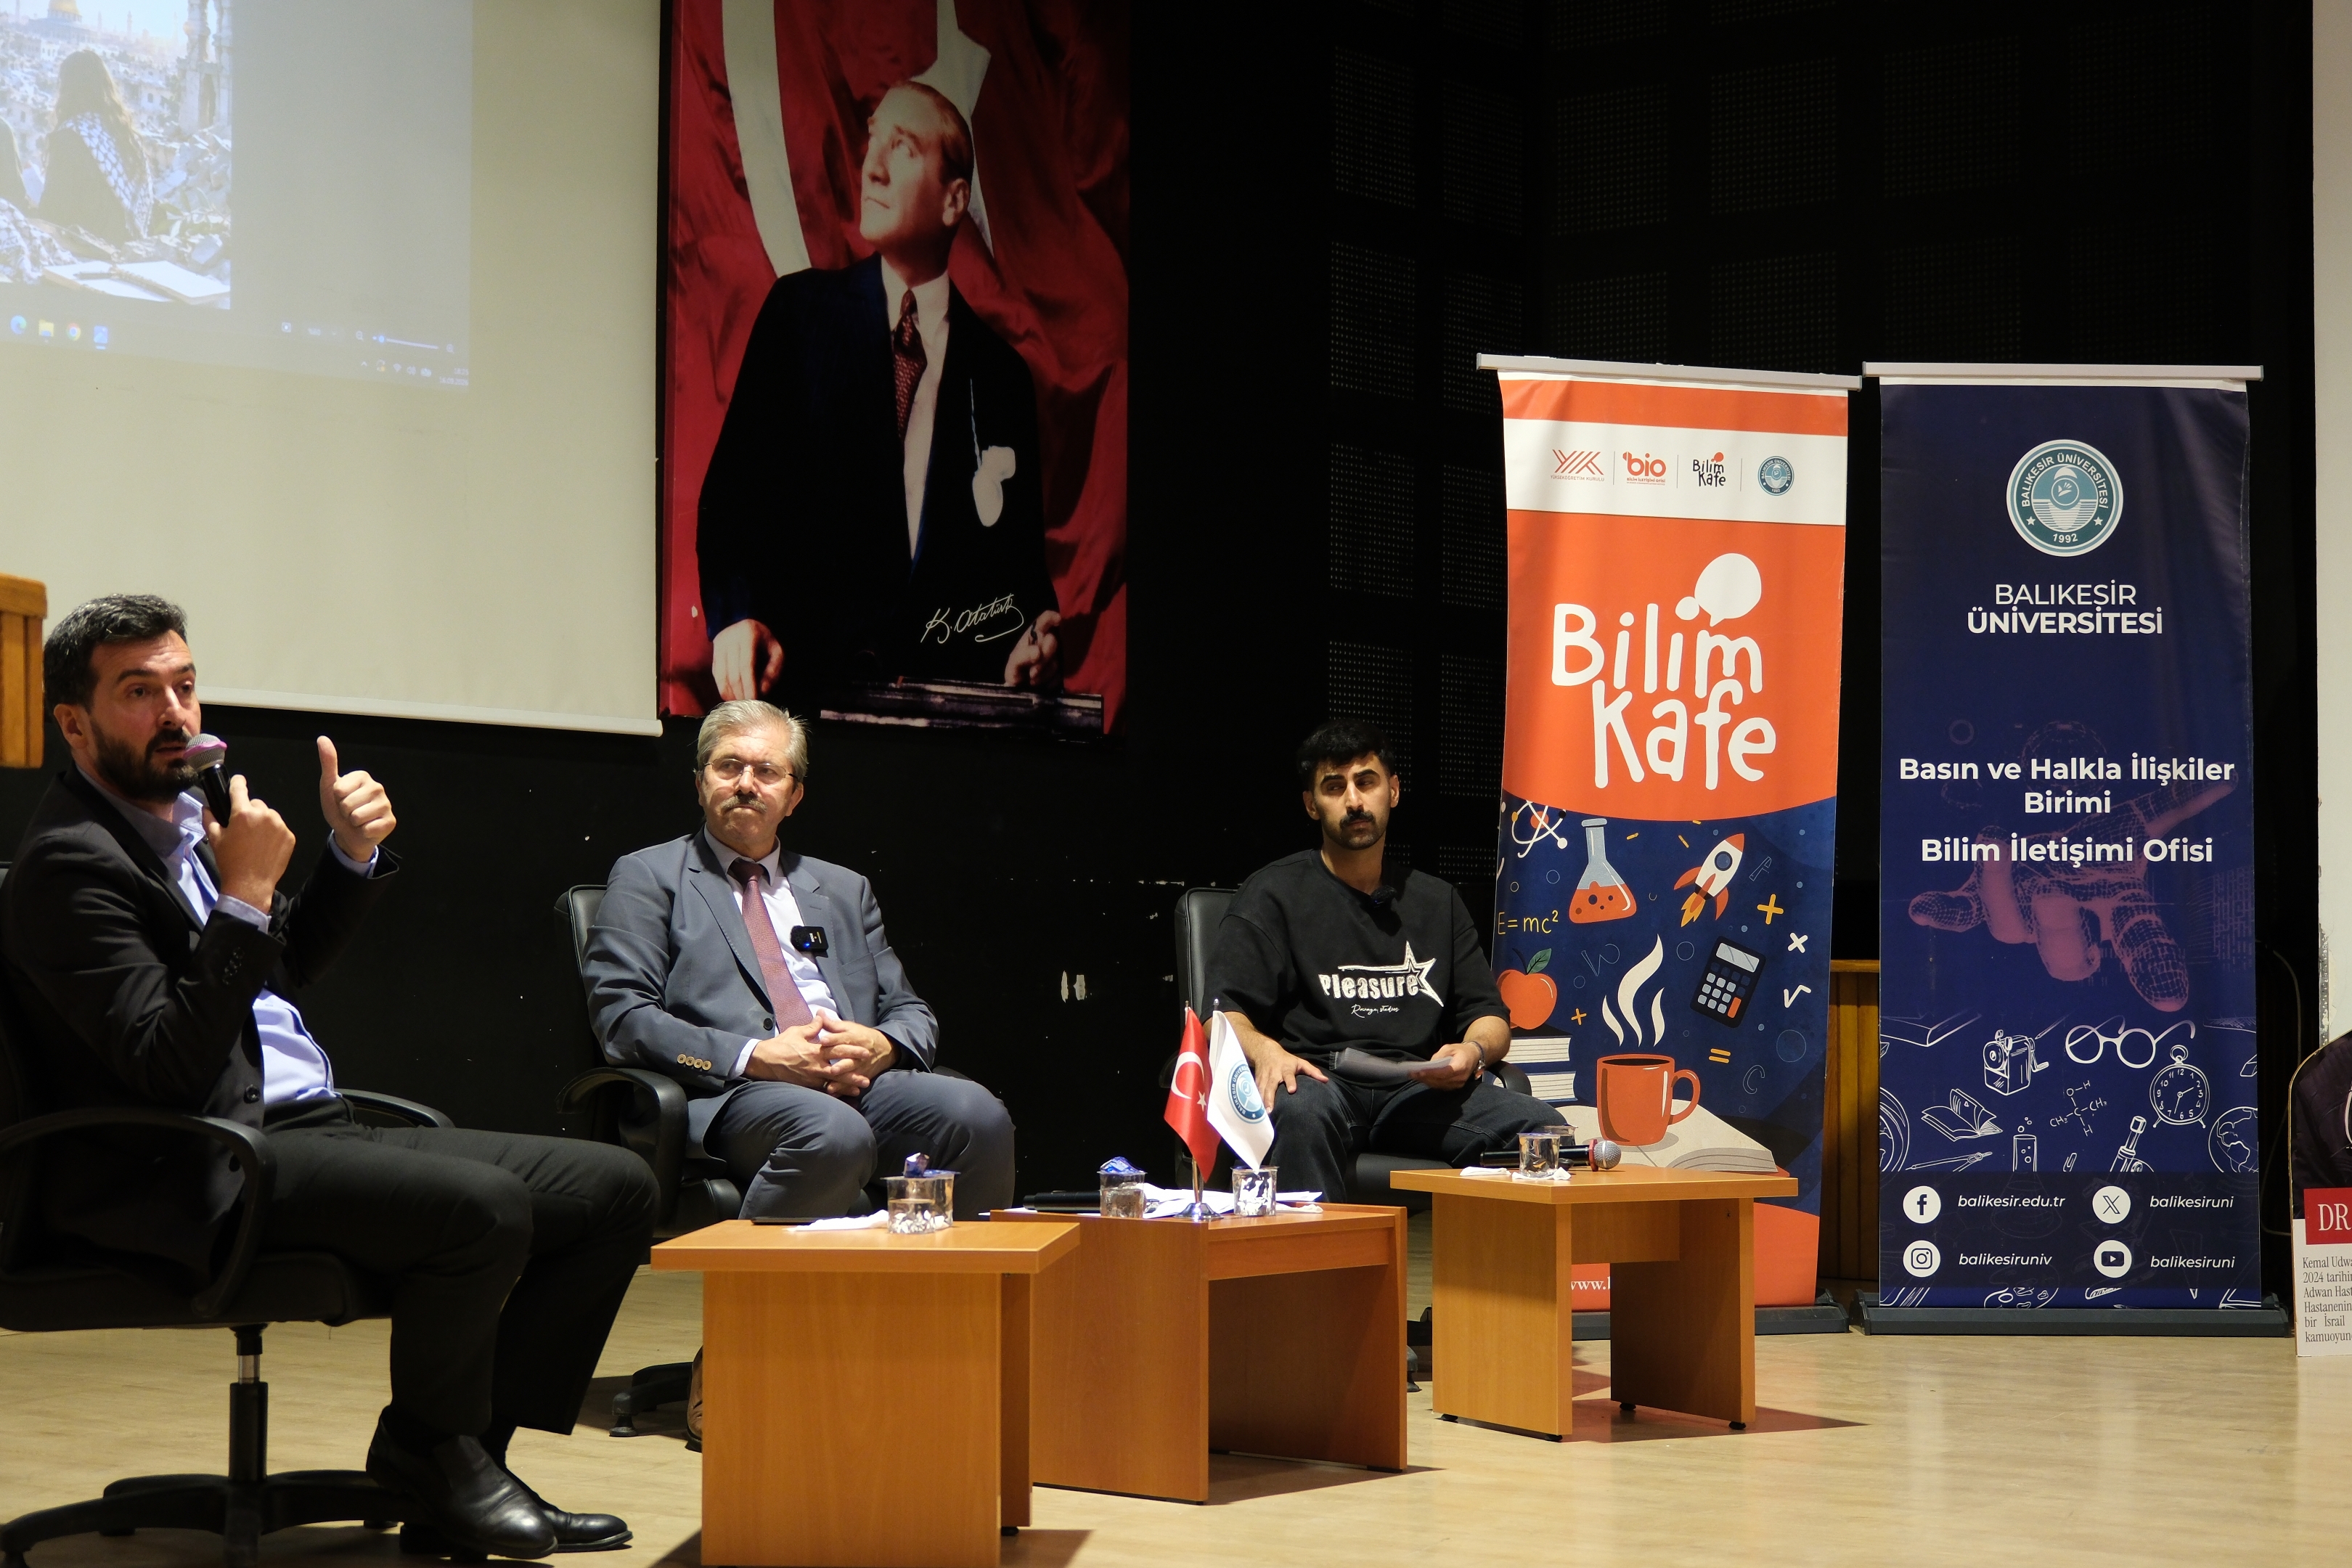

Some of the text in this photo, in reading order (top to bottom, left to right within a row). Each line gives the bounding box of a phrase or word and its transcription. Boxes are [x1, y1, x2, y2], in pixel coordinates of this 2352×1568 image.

[1692, 459, 1724, 473] Bilim
[1699, 470, 1726, 487] Kafe
[2021, 452, 2109, 509] BALIKESİR ÜNİVERSİTESİ
[2052, 533, 2078, 543] 1992
[1996, 579, 2136, 605] BALIKESİR
[1967, 606, 2163, 634] ÜNİVERSİTESİ
[1551, 603, 1763, 698] Bilim
[1592, 679, 1776, 791] Kafe
[1899, 752, 2235, 786] Basın ve Halkla İlişkiler
[2025, 790, 2111, 814] Birimi
[1921, 833, 2213, 867] Bilim İletişimi Ofisi
[1318, 973, 1420, 1000] Pleasure
[1958, 1194, 2066, 1207] balikesir.edu.tr
[2149, 1196, 2234, 1208] balikesiruni
[2317, 1203, 2352, 1231] DR
[1959, 1253, 2053, 1265] balikesiruniv
[2150, 1255, 2236, 1268] balikesiruni
[2303, 1257, 2329, 1269] Kemal
[2303, 1271, 2324, 1283] 2024
[2303, 1286, 2332, 1298] Adwan
[2304, 1300, 2352, 1313] Hastanenin
[2305, 1313, 2345, 1328] bir İsrail
[2306, 1331, 2352, 1344] kamuoyun
